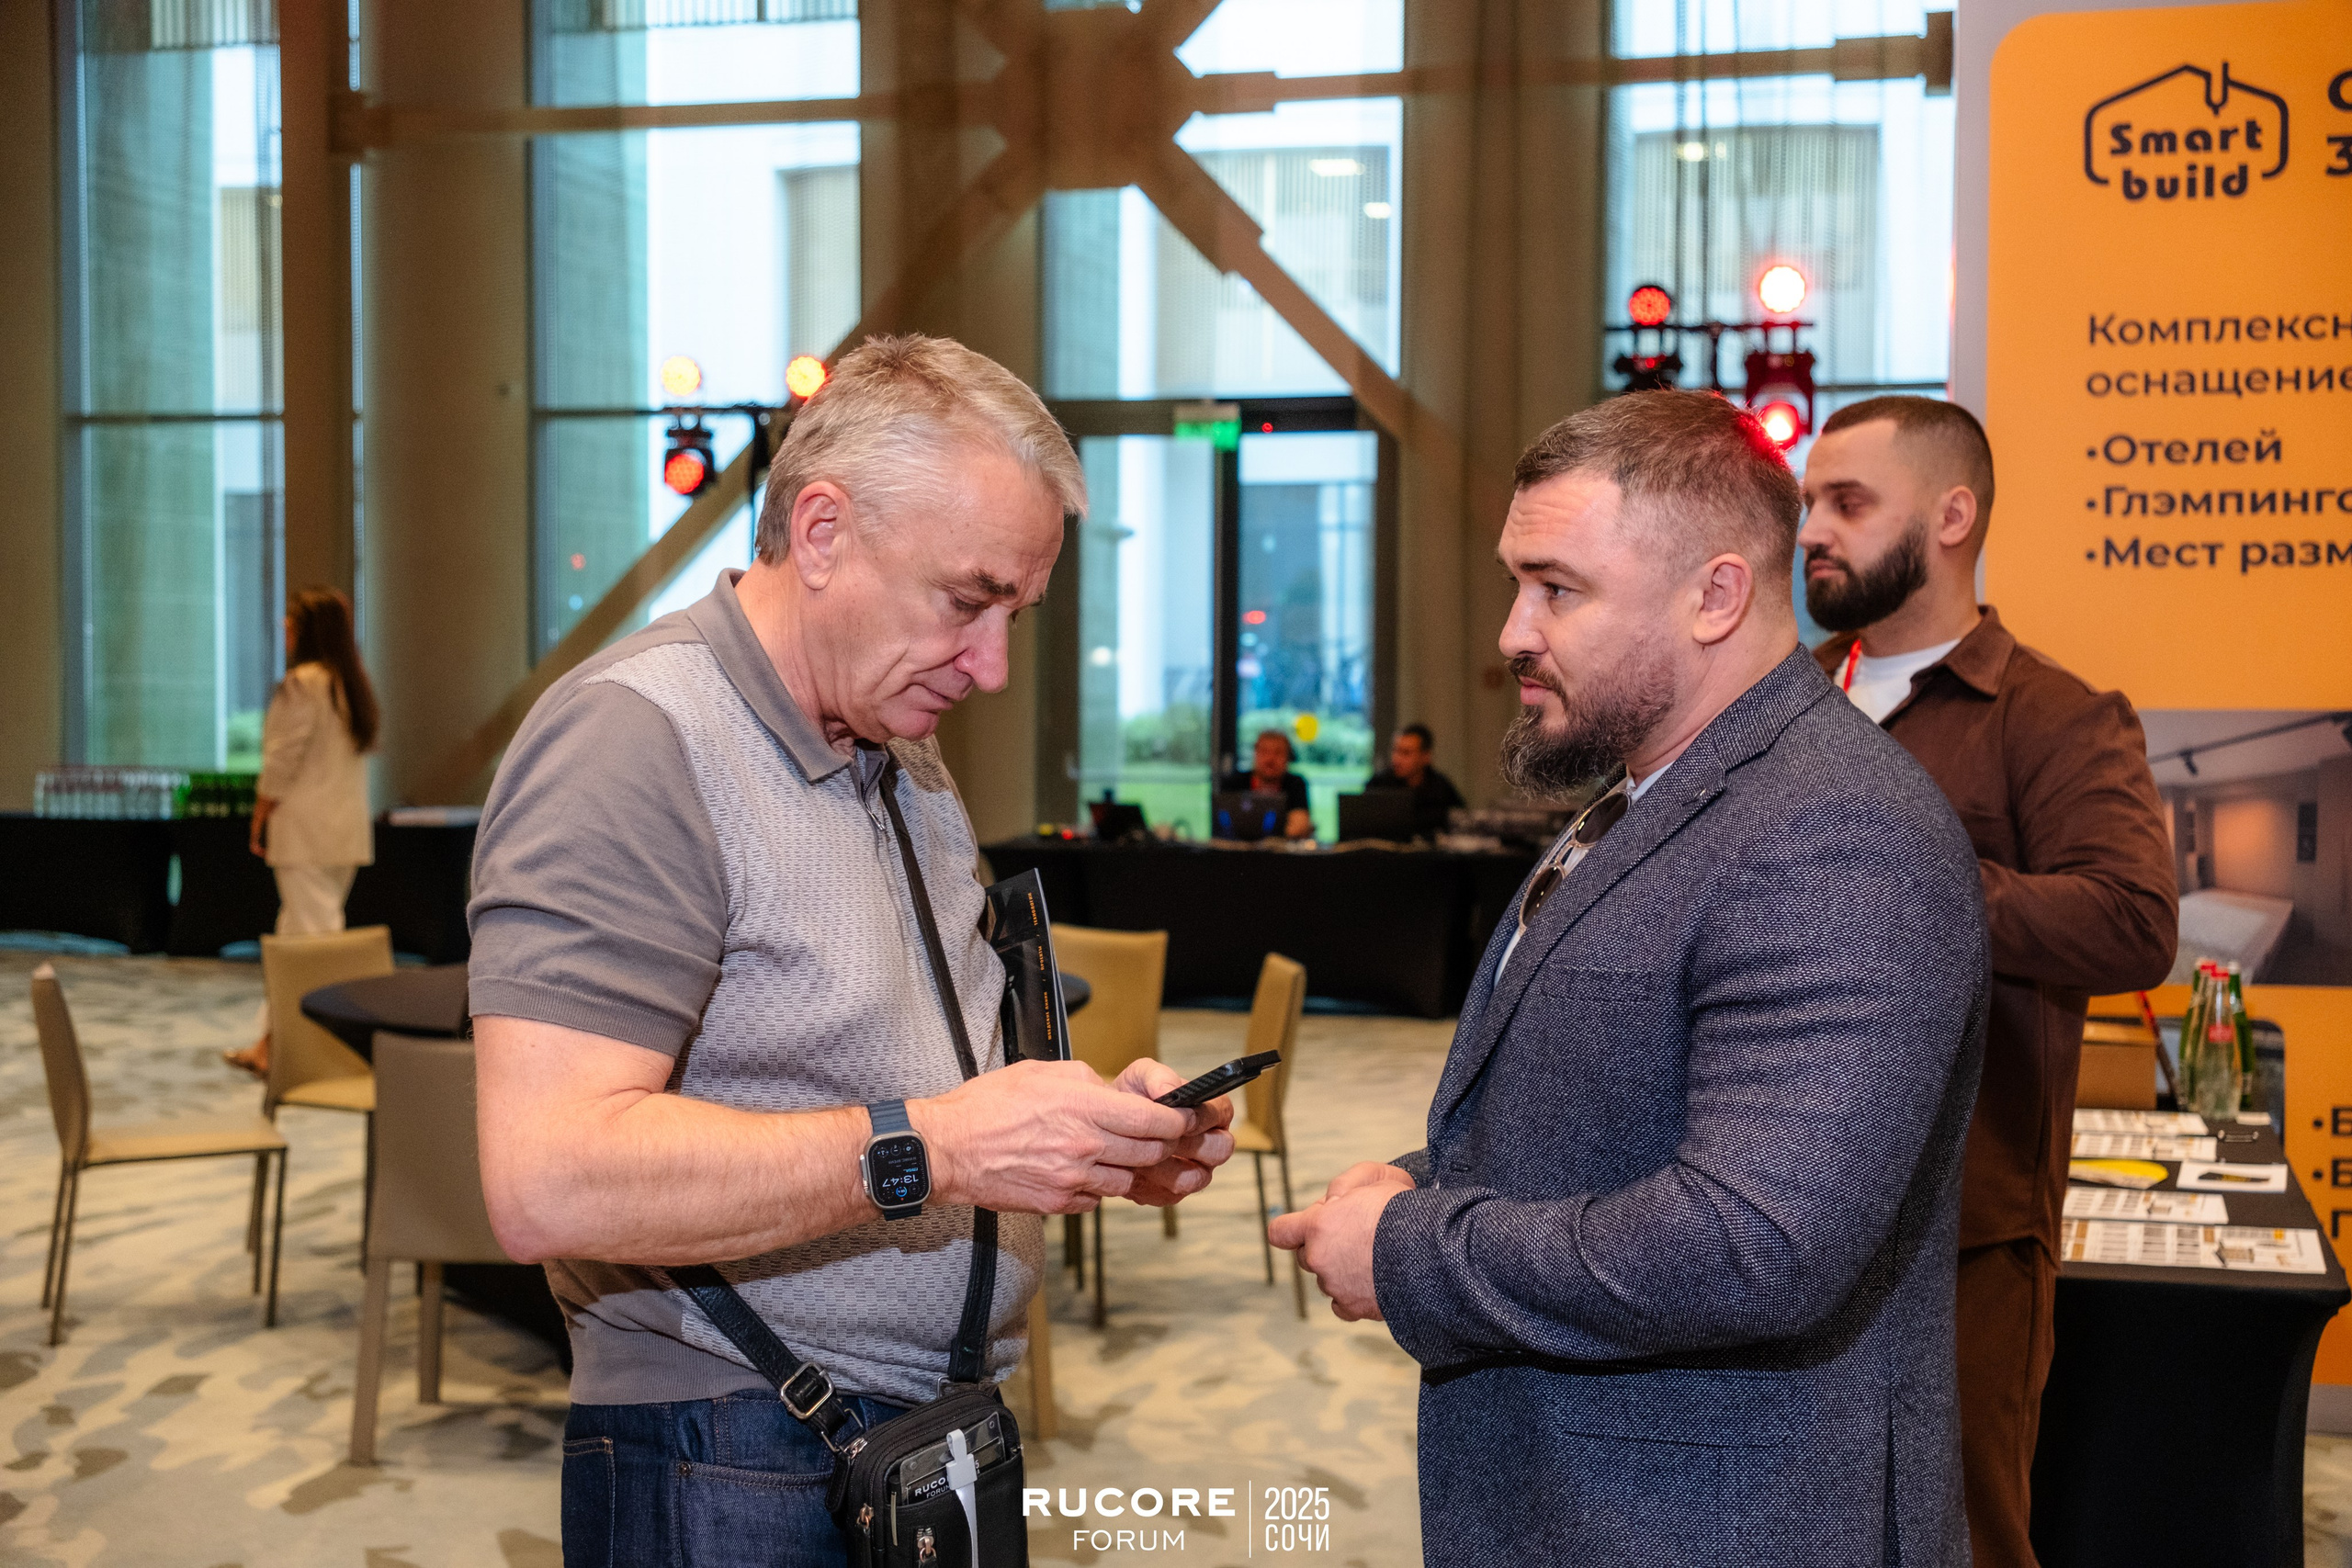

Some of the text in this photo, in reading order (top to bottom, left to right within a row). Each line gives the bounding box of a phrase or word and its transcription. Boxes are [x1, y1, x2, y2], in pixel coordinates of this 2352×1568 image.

[2110, 120, 2262, 155] Smart
[2122, 164, 2248, 200] build
[2089, 313, 2352, 345] Комплексн
[2240, 540, 2352, 576] разм
[882, 1174, 919, 1188] 13:47
[915, 1476, 946, 1497] RUCO
